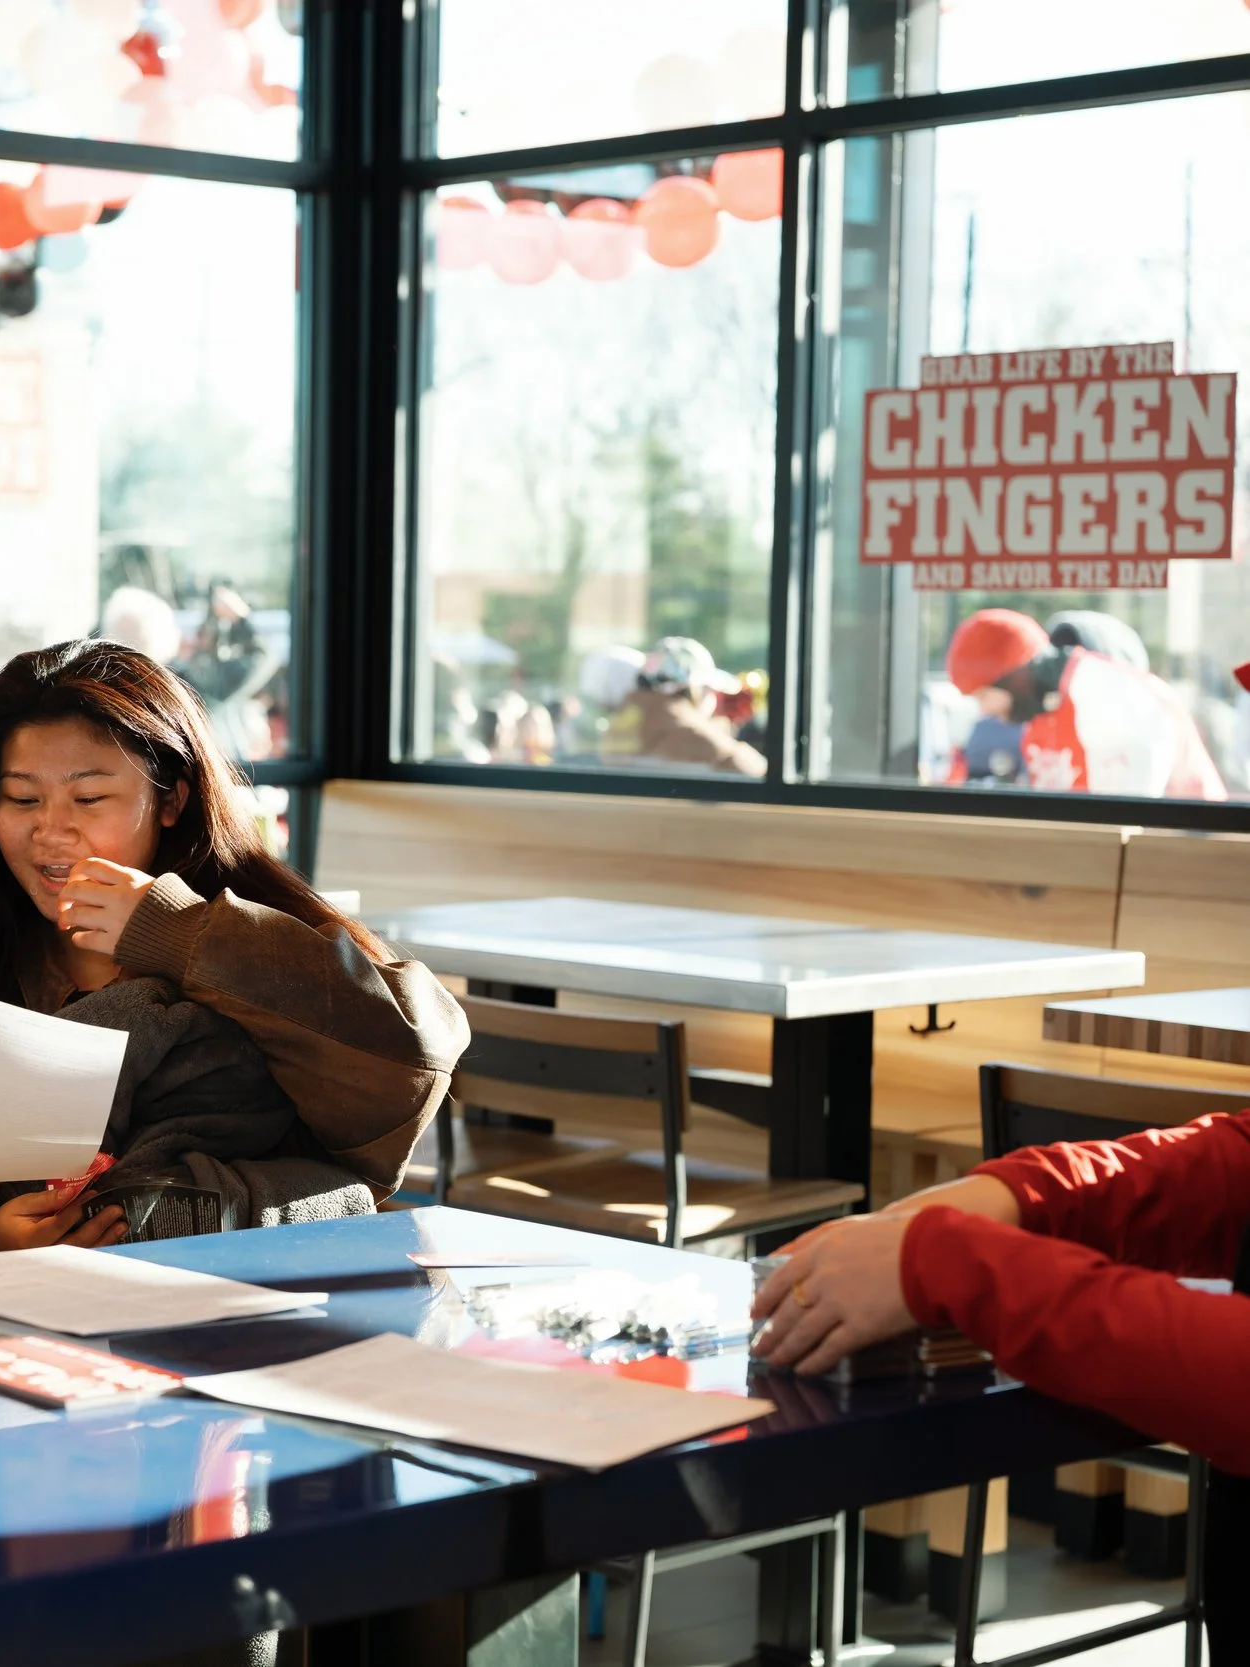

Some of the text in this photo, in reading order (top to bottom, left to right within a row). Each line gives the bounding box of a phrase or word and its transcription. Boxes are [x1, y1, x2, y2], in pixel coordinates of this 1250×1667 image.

[923, 343, 1173, 385] GRAB LIFE BY THE
[868, 374, 1233, 470] CHICKEN
[864, 469, 1226, 557] FINGERS
[915, 559, 1167, 587] AND SAVOR THE DAY
